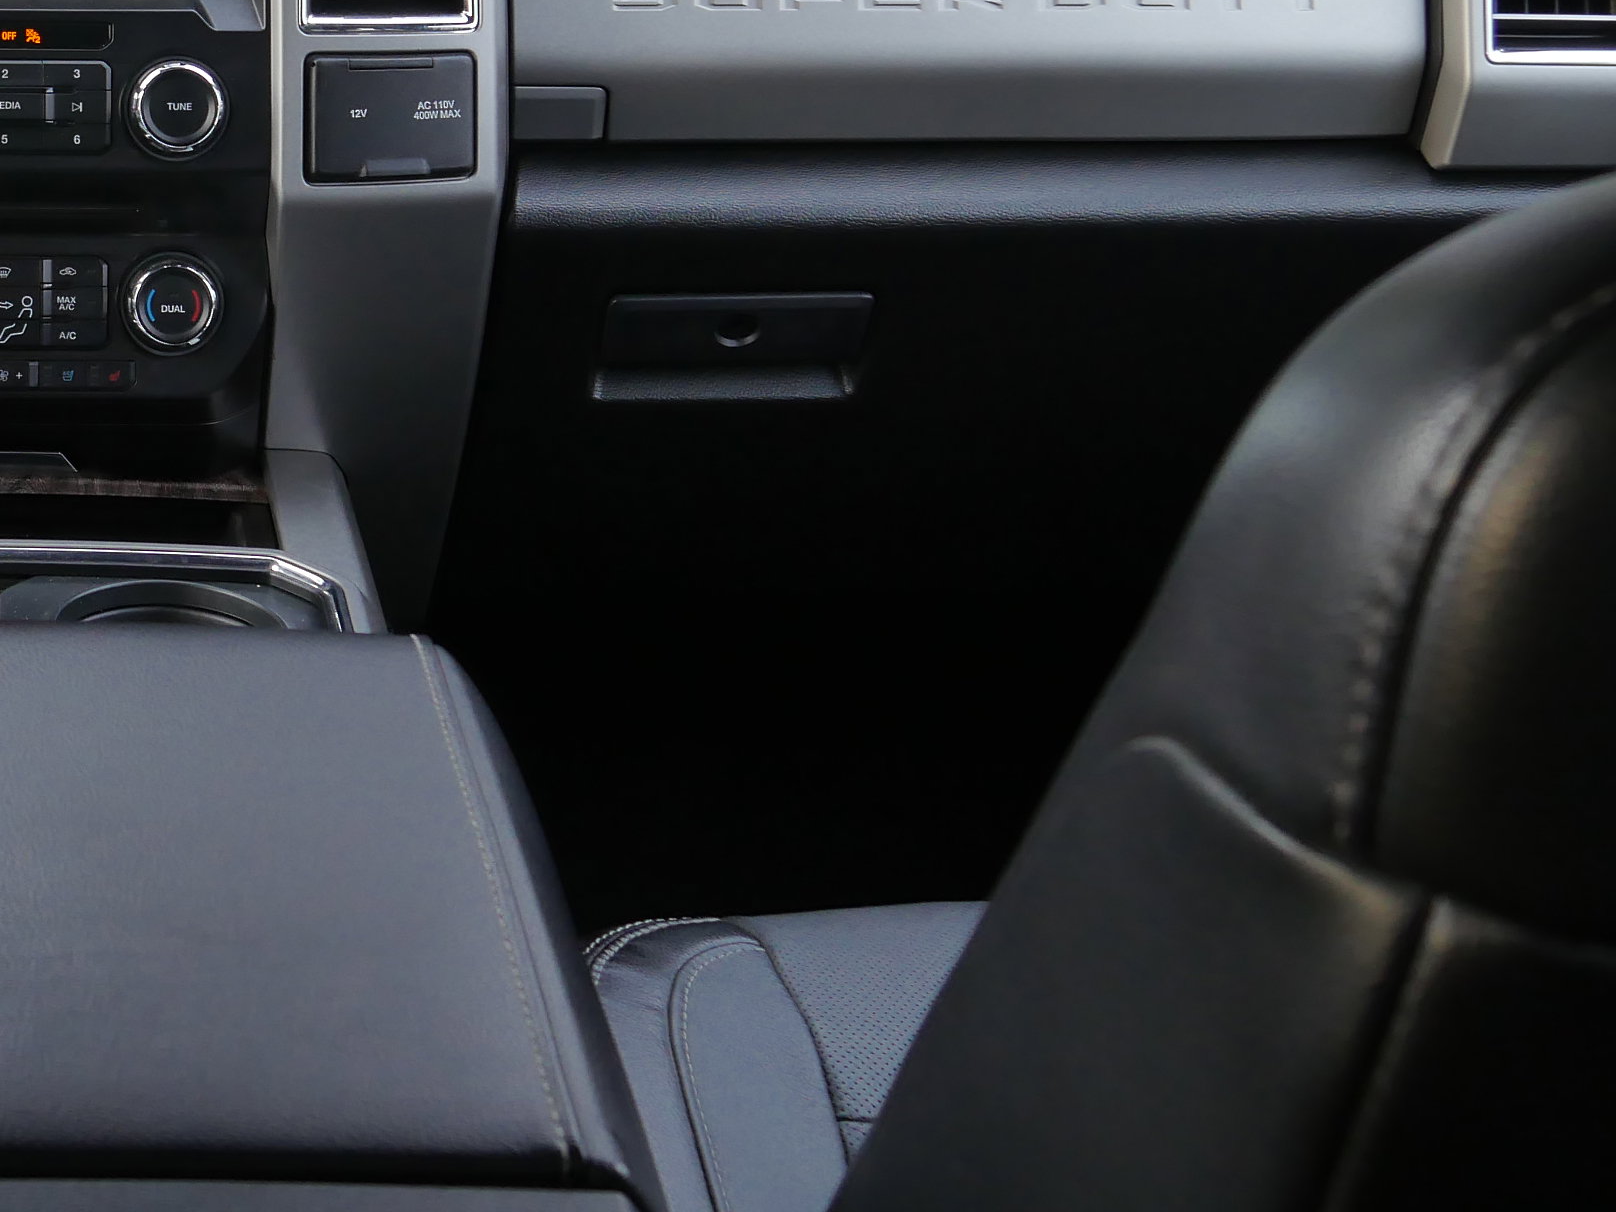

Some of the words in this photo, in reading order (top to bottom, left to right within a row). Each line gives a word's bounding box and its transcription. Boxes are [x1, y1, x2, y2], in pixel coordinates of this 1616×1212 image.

[1, 30, 17, 41] OFF
[1, 68, 9, 79] 2
[72, 68, 81, 79] 3
[166, 101, 193, 112] TUNE
[417, 101, 432, 110] AC
[432, 100, 456, 110] 110V
[349, 108, 368, 119] 12V
[413, 110, 438, 121] 400W
[439, 109, 462, 120] MAX
[0, 133, 9, 144] 5
[72, 134, 81, 145] 6
[56, 295, 76, 305] MAX
[58, 302, 76, 312] A/C
[160, 304, 186, 314] DUAL
[58, 331, 77, 341] A/C
